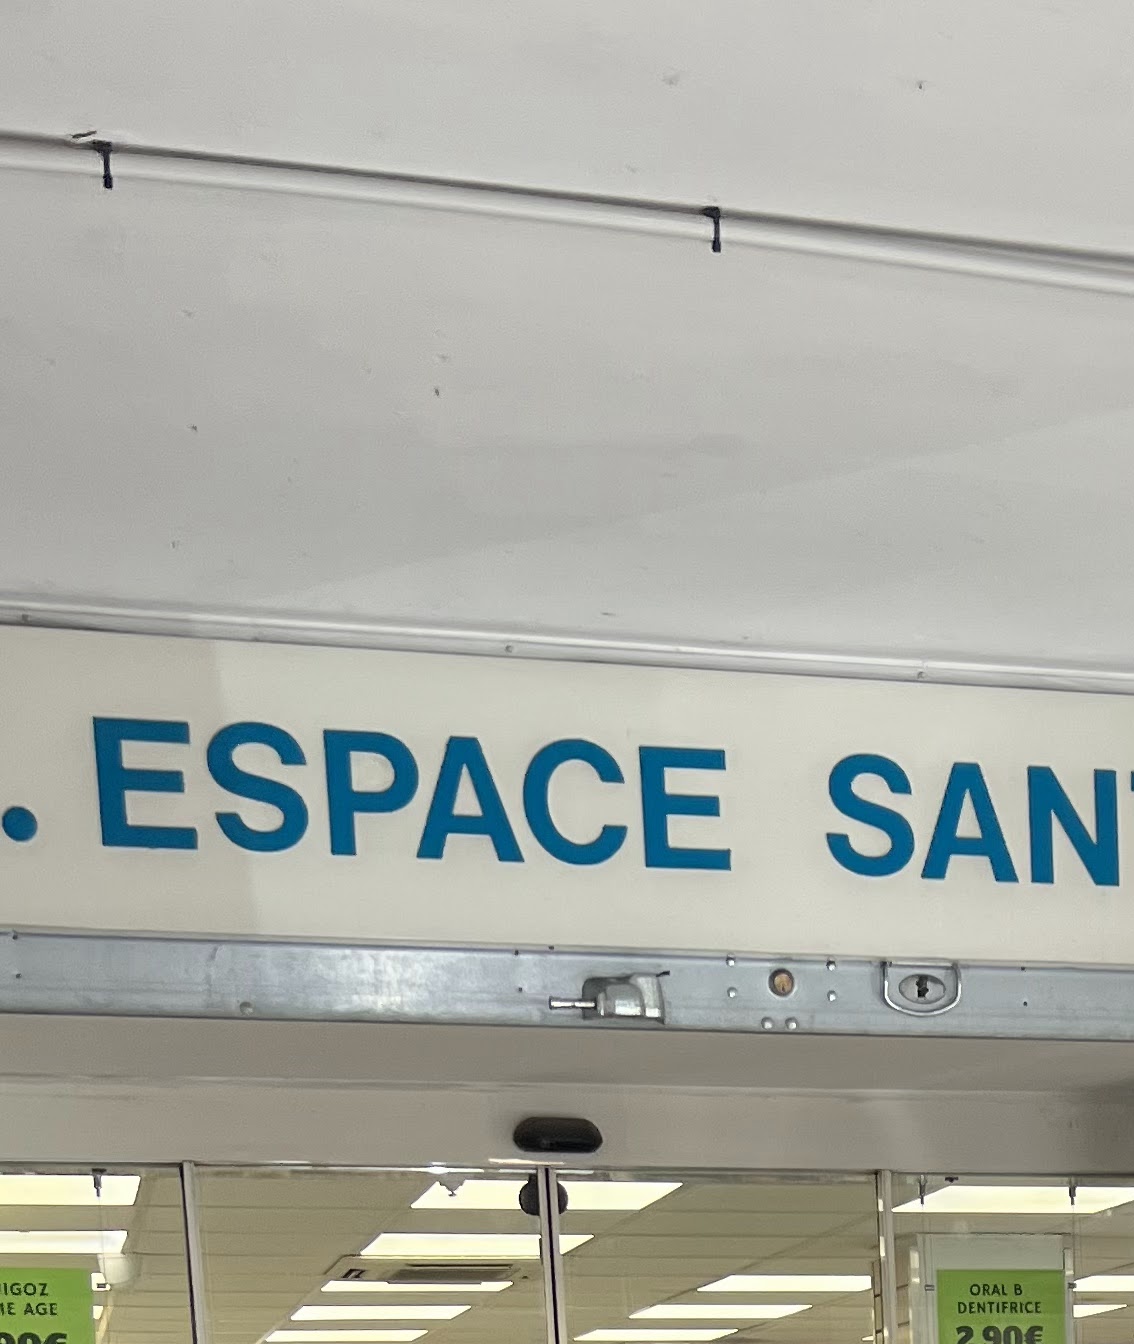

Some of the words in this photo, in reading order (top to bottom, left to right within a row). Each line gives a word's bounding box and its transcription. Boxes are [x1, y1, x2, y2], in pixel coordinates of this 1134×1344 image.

[93, 716, 732, 871] ESPACE
[0, 1282, 49, 1297] IGOZ
[969, 1283, 1008, 1296] ORAL
[1014, 1283, 1023, 1296] B
[23, 1302, 58, 1316] AGE
[958, 1301, 1042, 1314] DENTIFRICE
